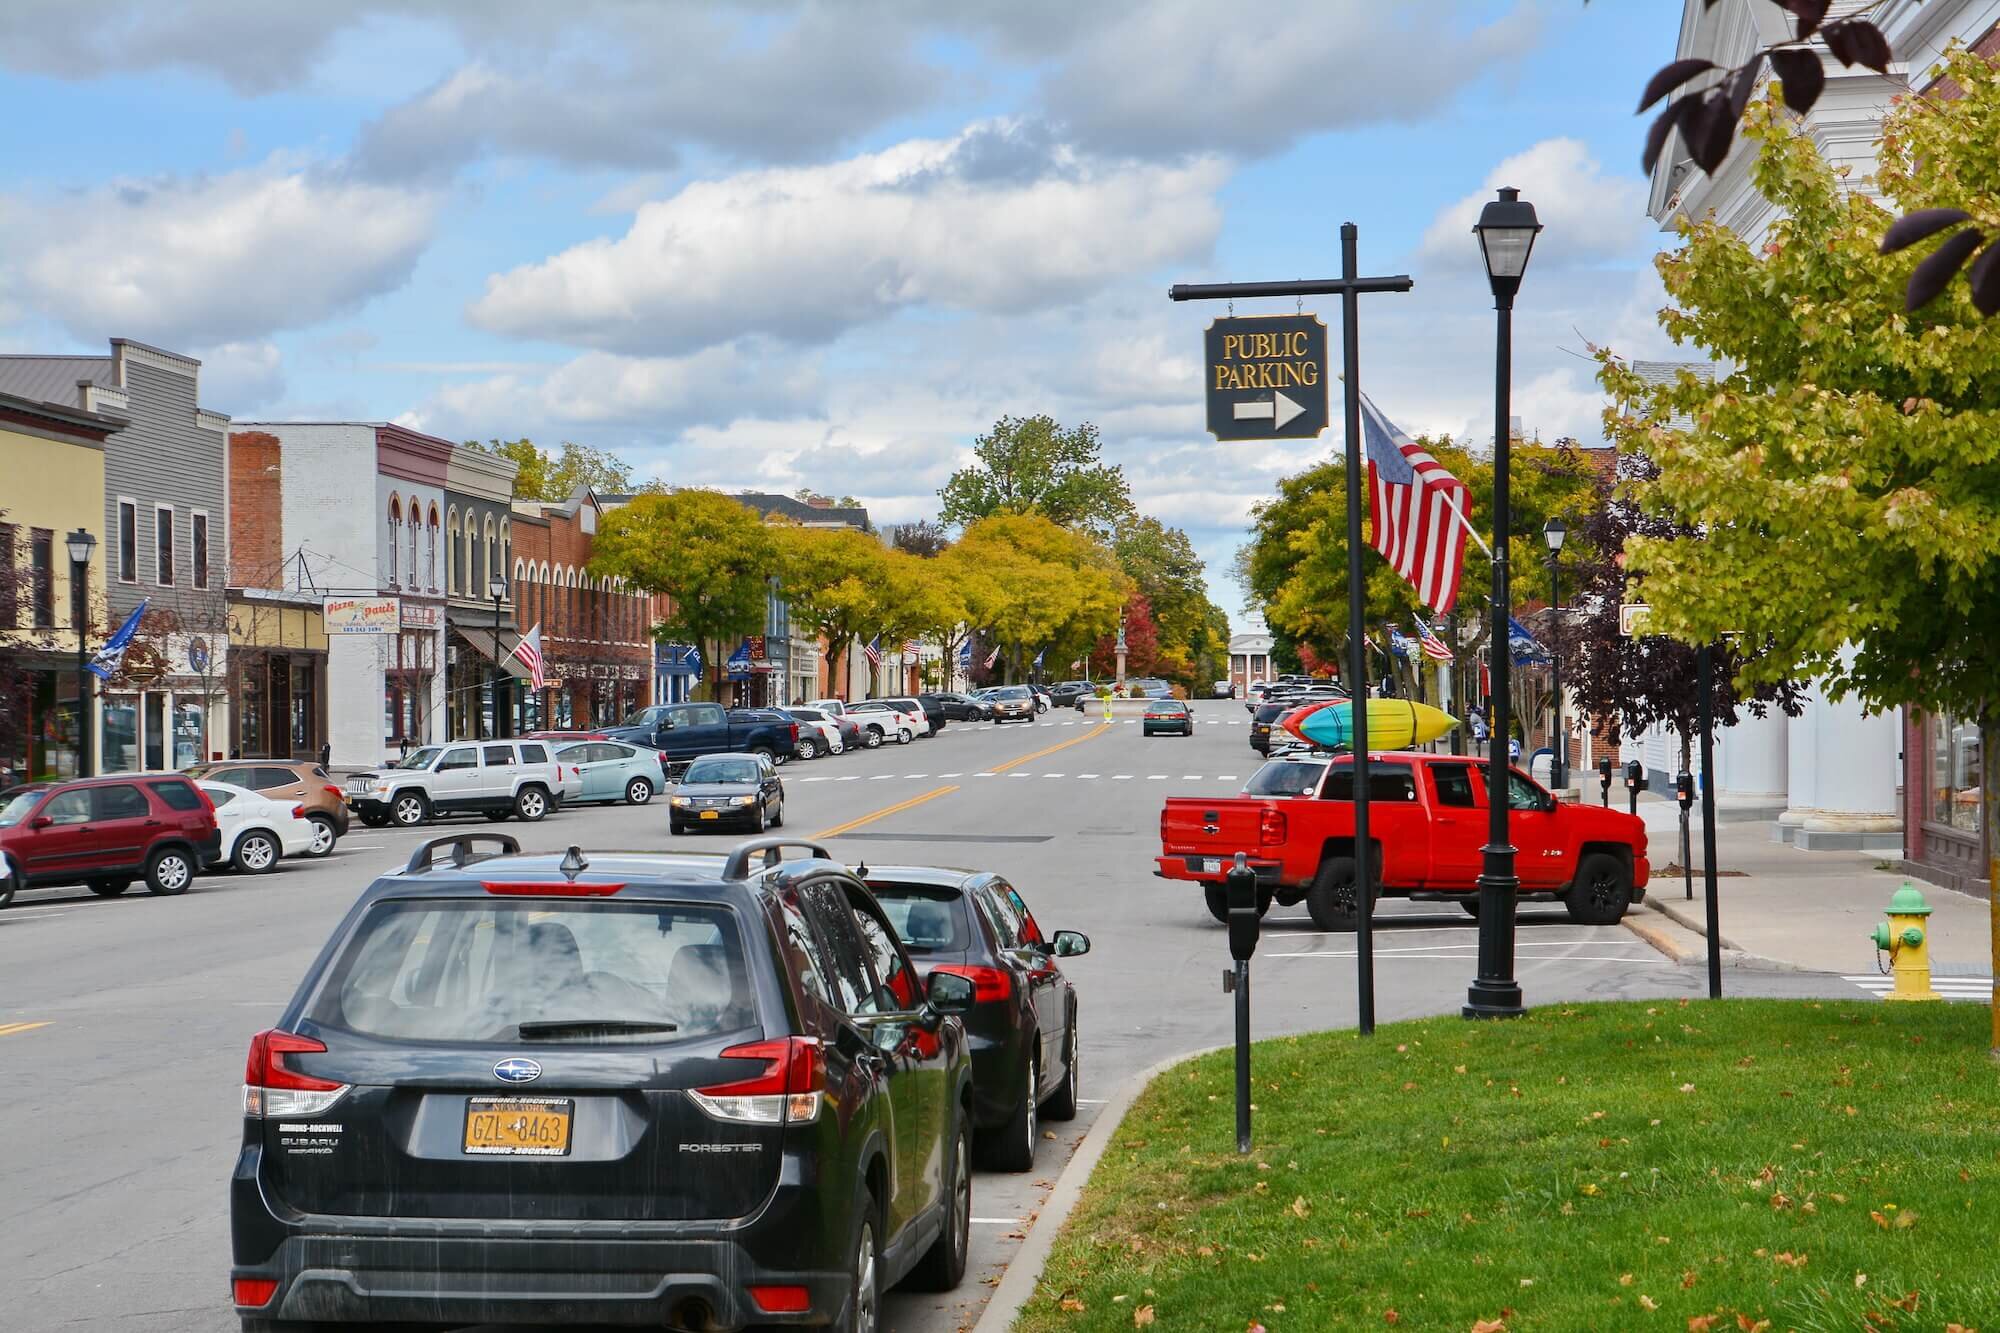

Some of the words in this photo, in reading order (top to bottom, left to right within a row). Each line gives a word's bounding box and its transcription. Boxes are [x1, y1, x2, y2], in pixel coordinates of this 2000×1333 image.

[1223, 331, 1308, 360] PUBLIC
[1214, 361, 1318, 390] PARKING
[493, 1103, 519, 1112] NEW
[520, 1103, 546, 1112] YORK
[473, 1115, 504, 1140] GZL
[518, 1116, 560, 1142] 8463
[281, 1138, 338, 1146] SUBARU
[679, 1143, 762, 1153] FORESTER
